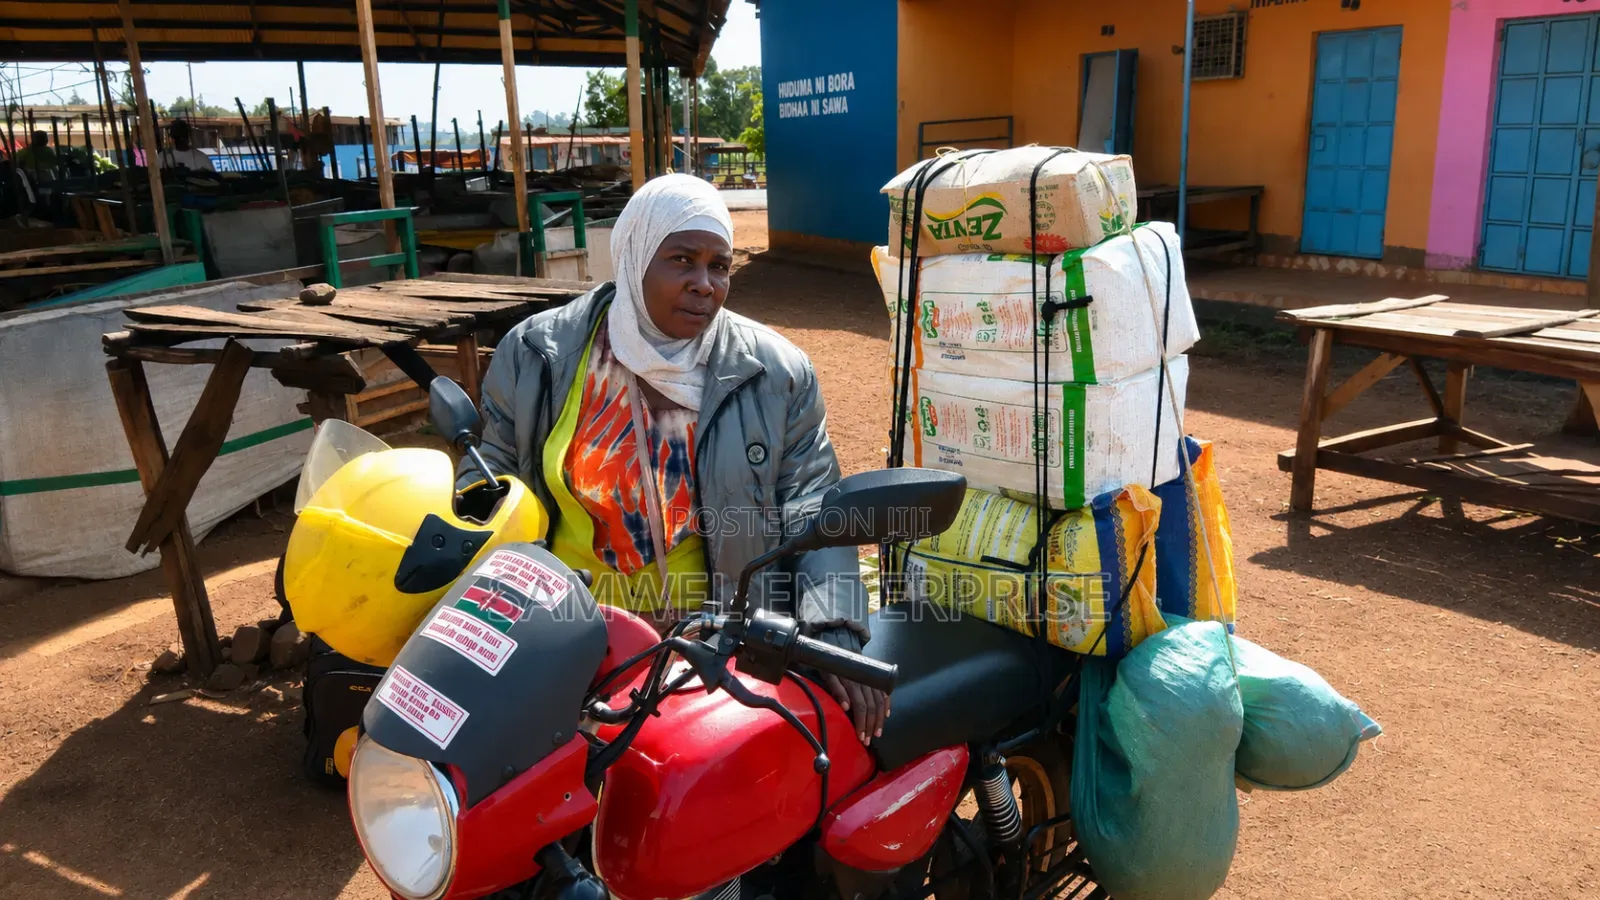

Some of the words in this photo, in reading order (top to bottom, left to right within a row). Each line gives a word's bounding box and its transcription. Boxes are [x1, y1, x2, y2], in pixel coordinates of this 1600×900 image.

[778, 78, 813, 99] HUDUMA
[815, 76, 825, 94] NI
[828, 71, 855, 93] BORA
[779, 100, 809, 119] BIDHAA
[811, 99, 820, 116] NI
[822, 96, 849, 115] SAWA
[927, 211, 1004, 241] ZENTA
